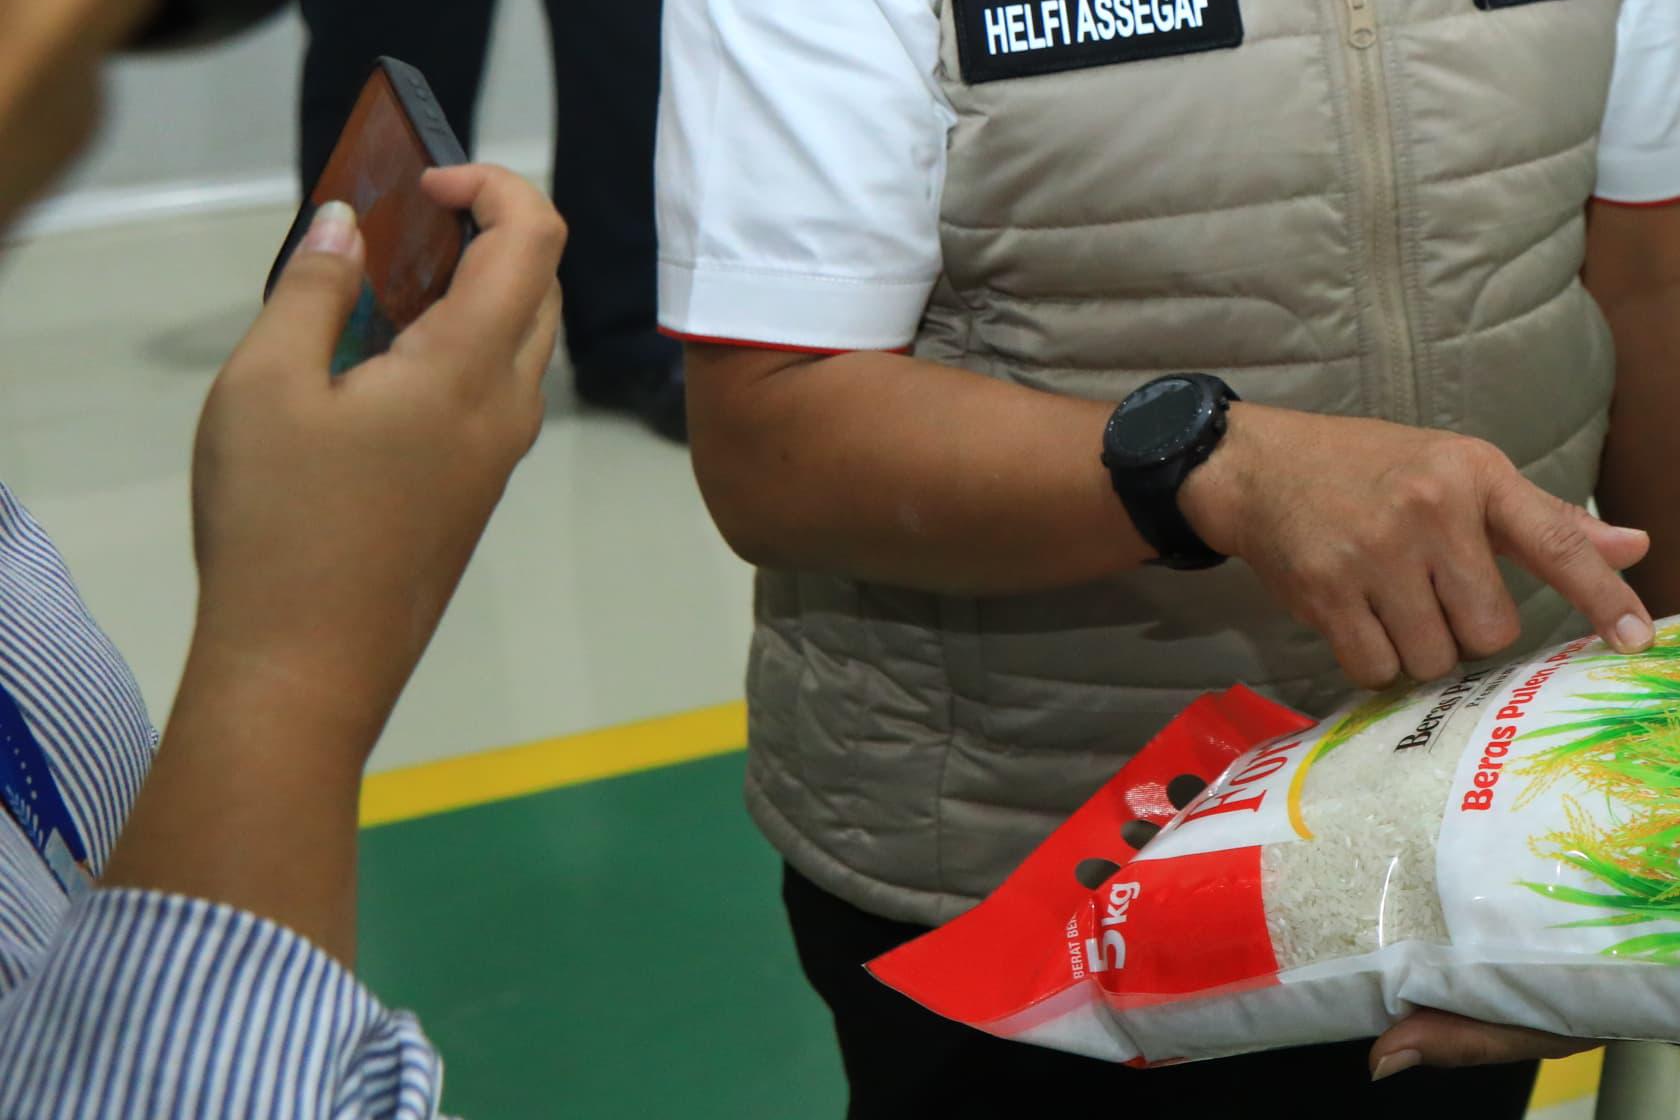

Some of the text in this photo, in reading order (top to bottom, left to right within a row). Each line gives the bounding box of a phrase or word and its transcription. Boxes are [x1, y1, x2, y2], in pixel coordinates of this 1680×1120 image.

[1394, 694, 1463, 753] Beras
[1461, 725, 1518, 812] Beras
[1067, 941, 1085, 980] BERAT
[1084, 881, 1141, 973] 5 kg
